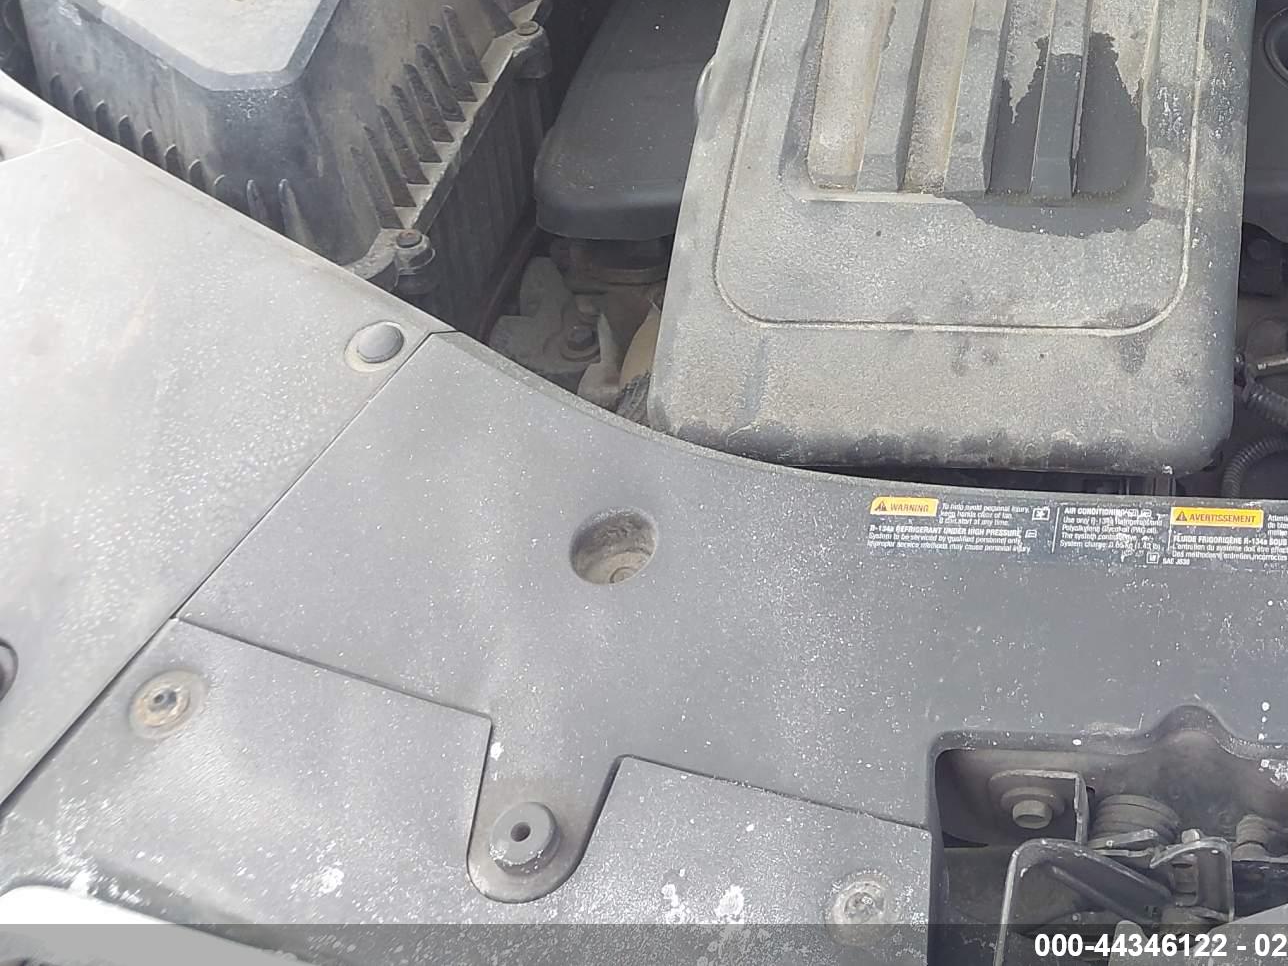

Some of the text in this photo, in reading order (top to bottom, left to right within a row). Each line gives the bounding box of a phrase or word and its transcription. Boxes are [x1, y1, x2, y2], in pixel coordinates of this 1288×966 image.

[890, 502, 929, 512] WARNING
[1189, 513, 1256, 523] AVERTISSEMENT
[896, 525, 942, 534] REFRIGERANT
[943, 527, 967, 535] UNDER
[968, 527, 985, 535] HIGH
[1173, 534, 1197, 543] FLUIDE
